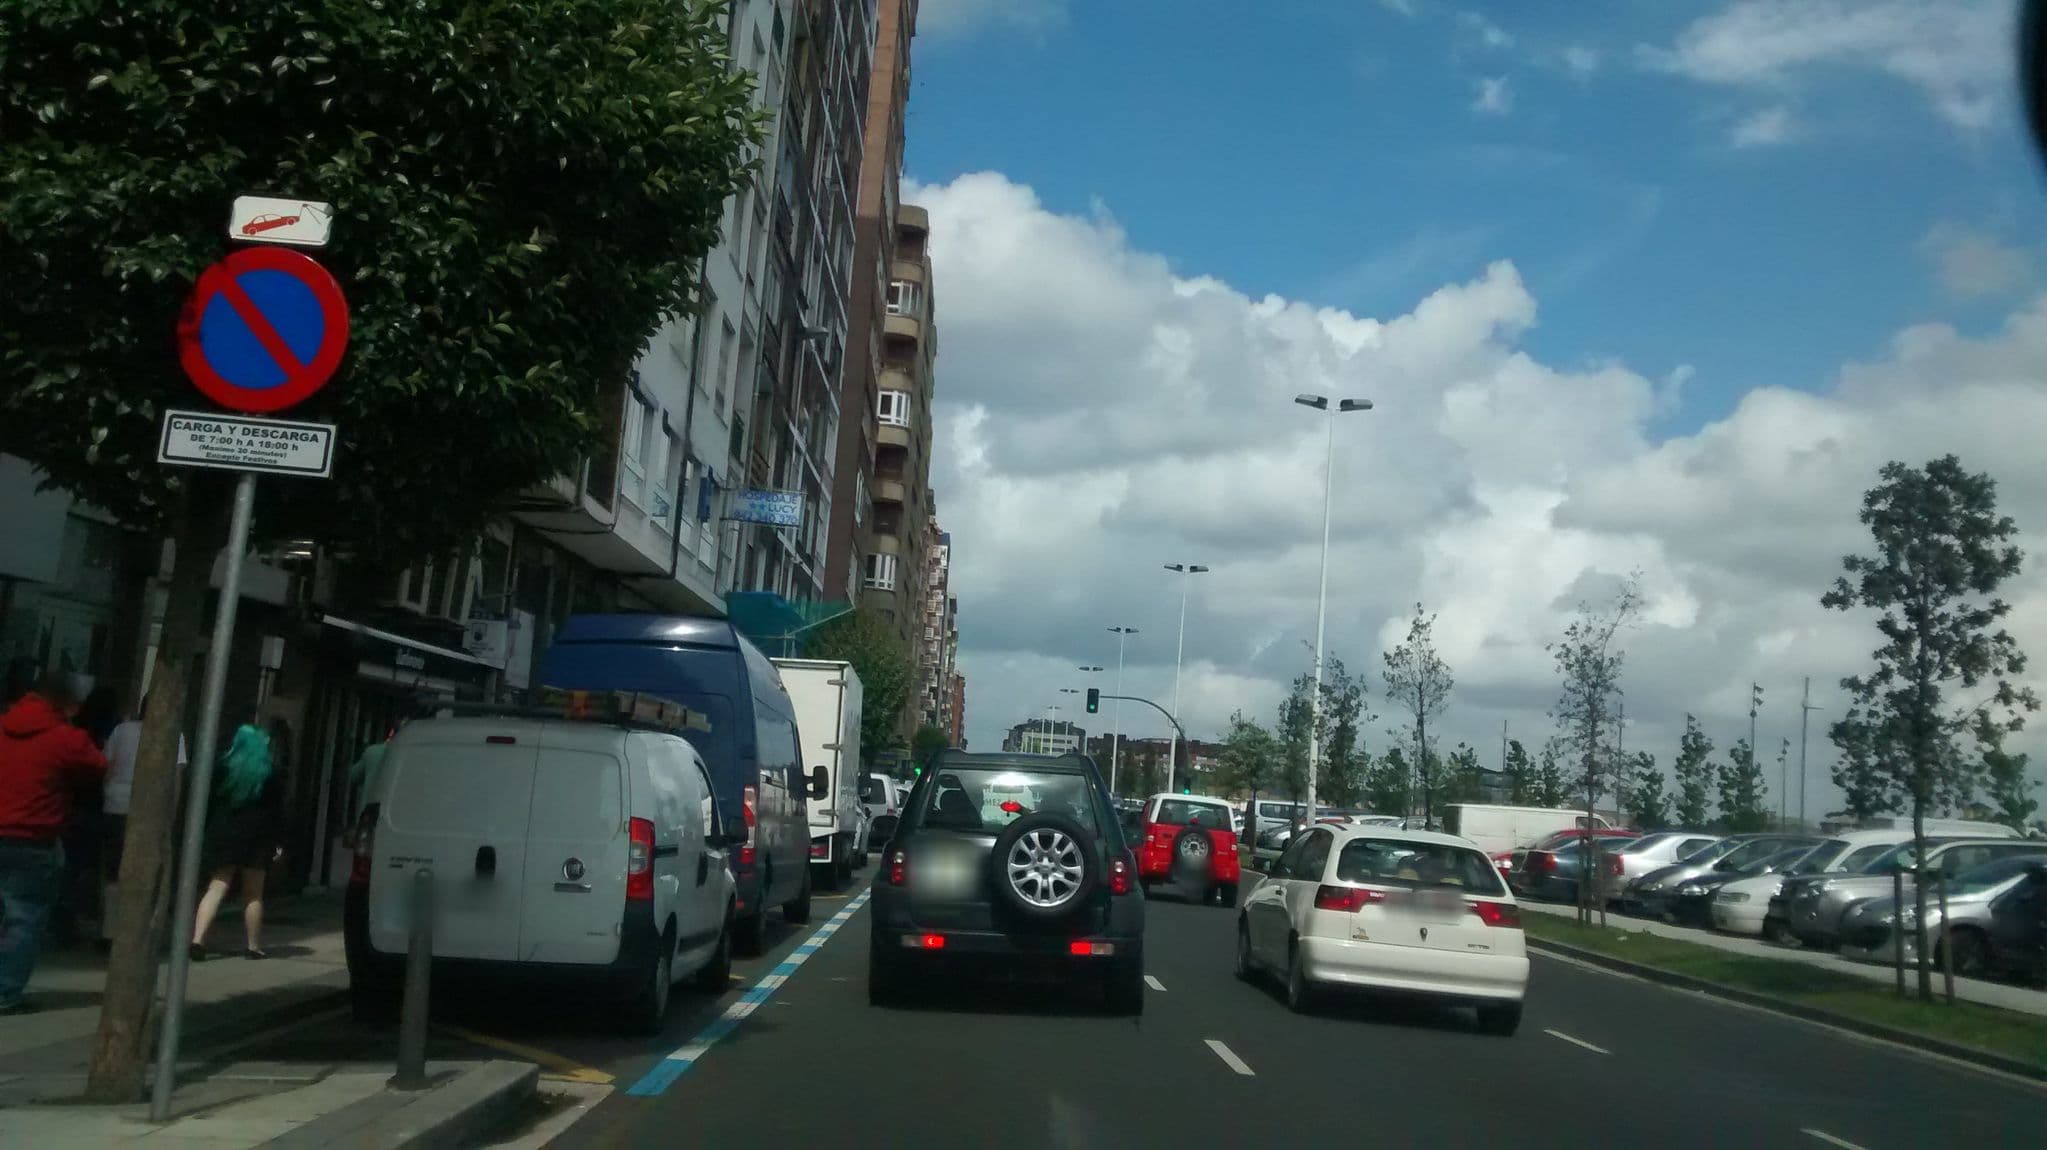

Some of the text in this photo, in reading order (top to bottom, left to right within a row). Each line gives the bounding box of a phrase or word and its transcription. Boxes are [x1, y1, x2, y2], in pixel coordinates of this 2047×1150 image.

[173, 420, 319, 443] CARGA Y DESCARGA
[190, 434, 299, 451] DE 7:00 h A 18:00 h
[768, 503, 798, 514] LUCY
